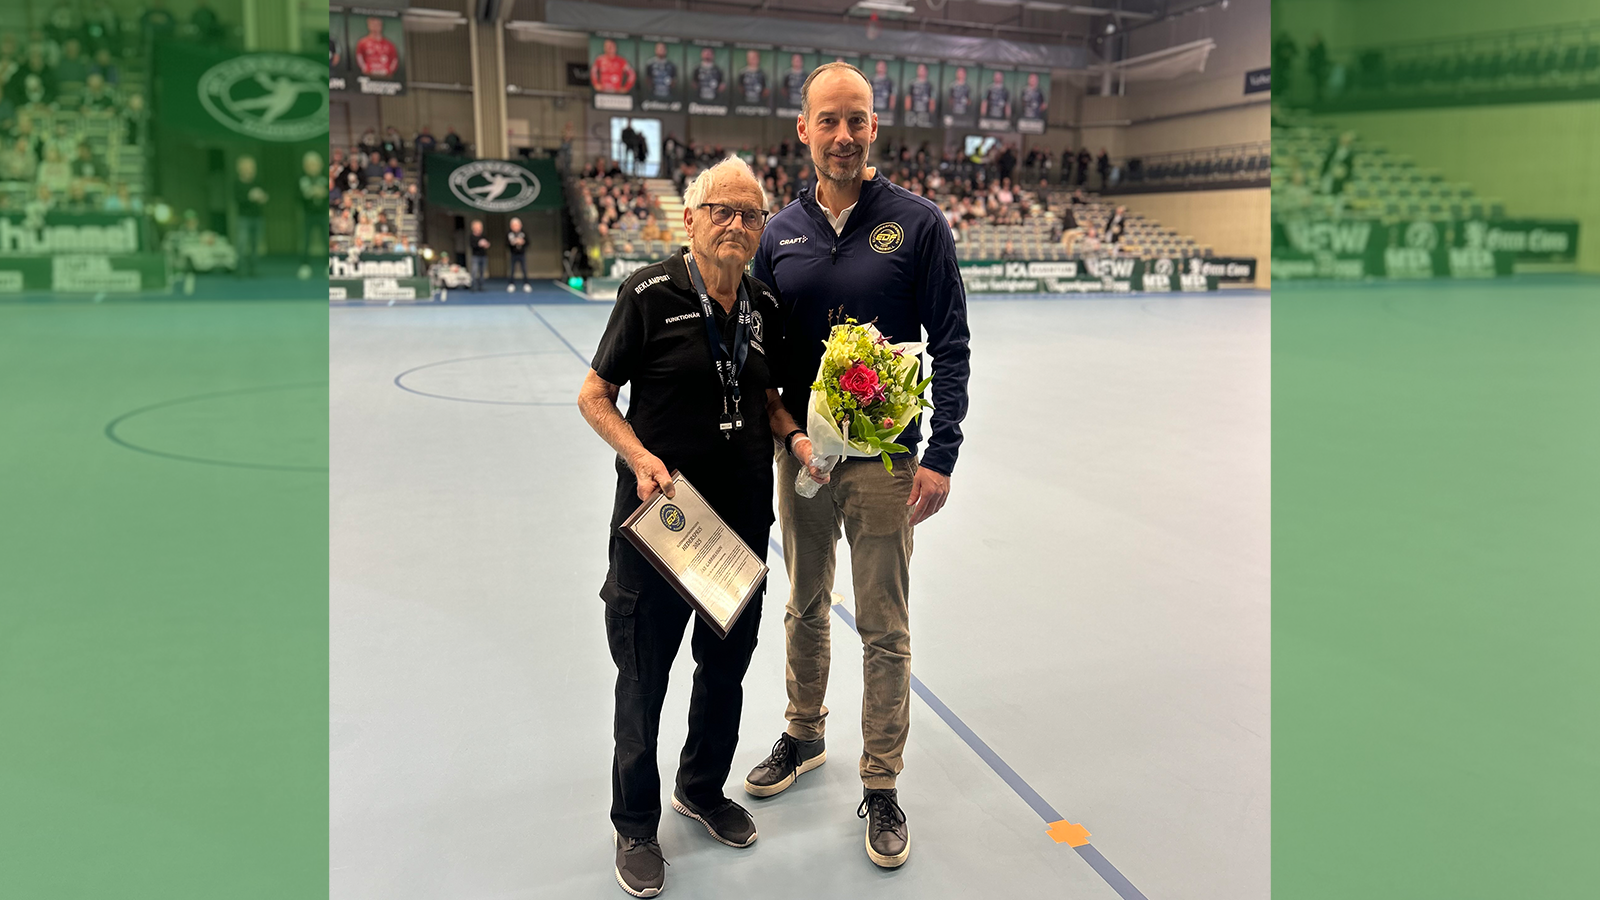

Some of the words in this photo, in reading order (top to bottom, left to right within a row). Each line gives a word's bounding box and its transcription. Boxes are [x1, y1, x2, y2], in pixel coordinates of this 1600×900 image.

[779, 236, 802, 246] CRAFT
[876, 233, 898, 241] EDF
[333, 255, 414, 277] hummel
[1005, 262, 1027, 278] ICA
[665, 311, 701, 324] FUNKTIONÄR
[682, 526, 703, 551] HEDERSPRIS
